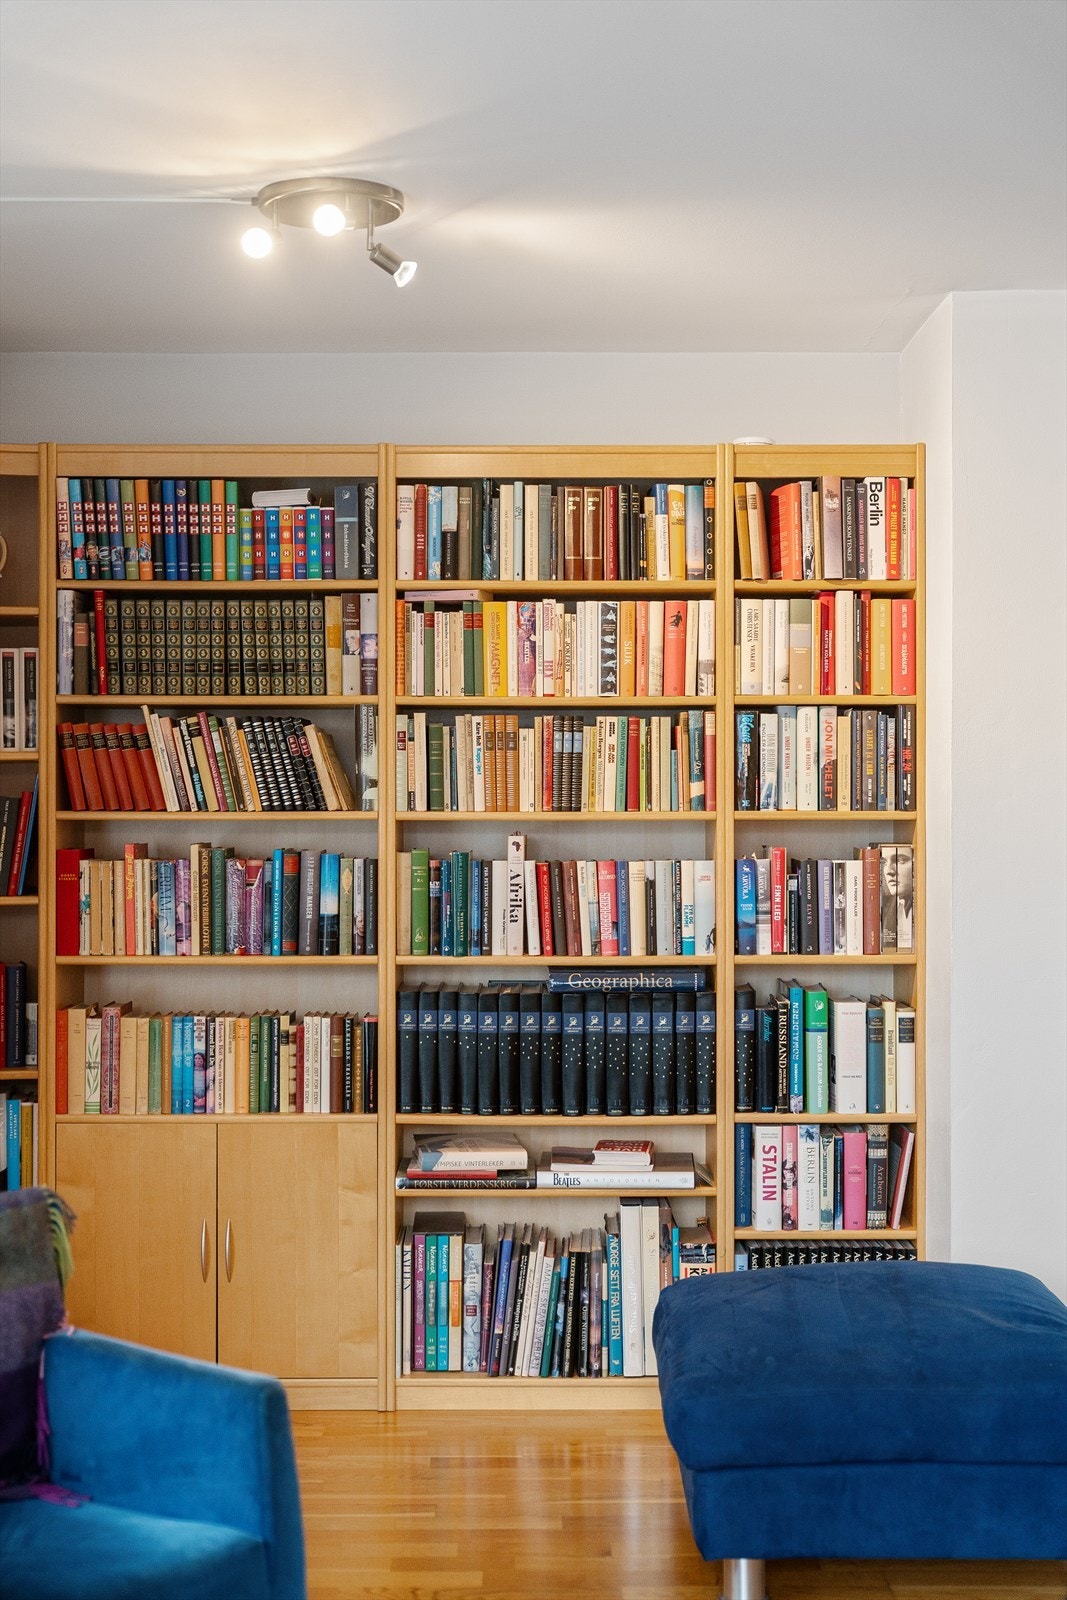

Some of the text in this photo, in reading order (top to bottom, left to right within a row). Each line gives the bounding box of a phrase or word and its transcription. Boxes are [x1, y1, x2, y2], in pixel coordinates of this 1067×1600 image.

[869, 481, 883, 527] Berlin
[490, 642, 501, 686] MAGNET
[624, 641, 632, 665] SLUK
[510, 870, 522, 924] Afrika
[568, 972, 672, 992] Geographica
[817, 1054, 822, 1062] OG
[186, 1100, 190, 1108] 2
[762, 1144, 777, 1200] STALIN
[806, 1147, 816, 1184] BERLIN
[414, 1180, 518, 1189] FØRSTE VERDENSKRIG
[541, 1262, 552, 1294] AMALIE
[610, 1238, 620, 1340] NORGE SETT FRA LUFTEN
[531, 1336, 543, 1369] VERDEN
